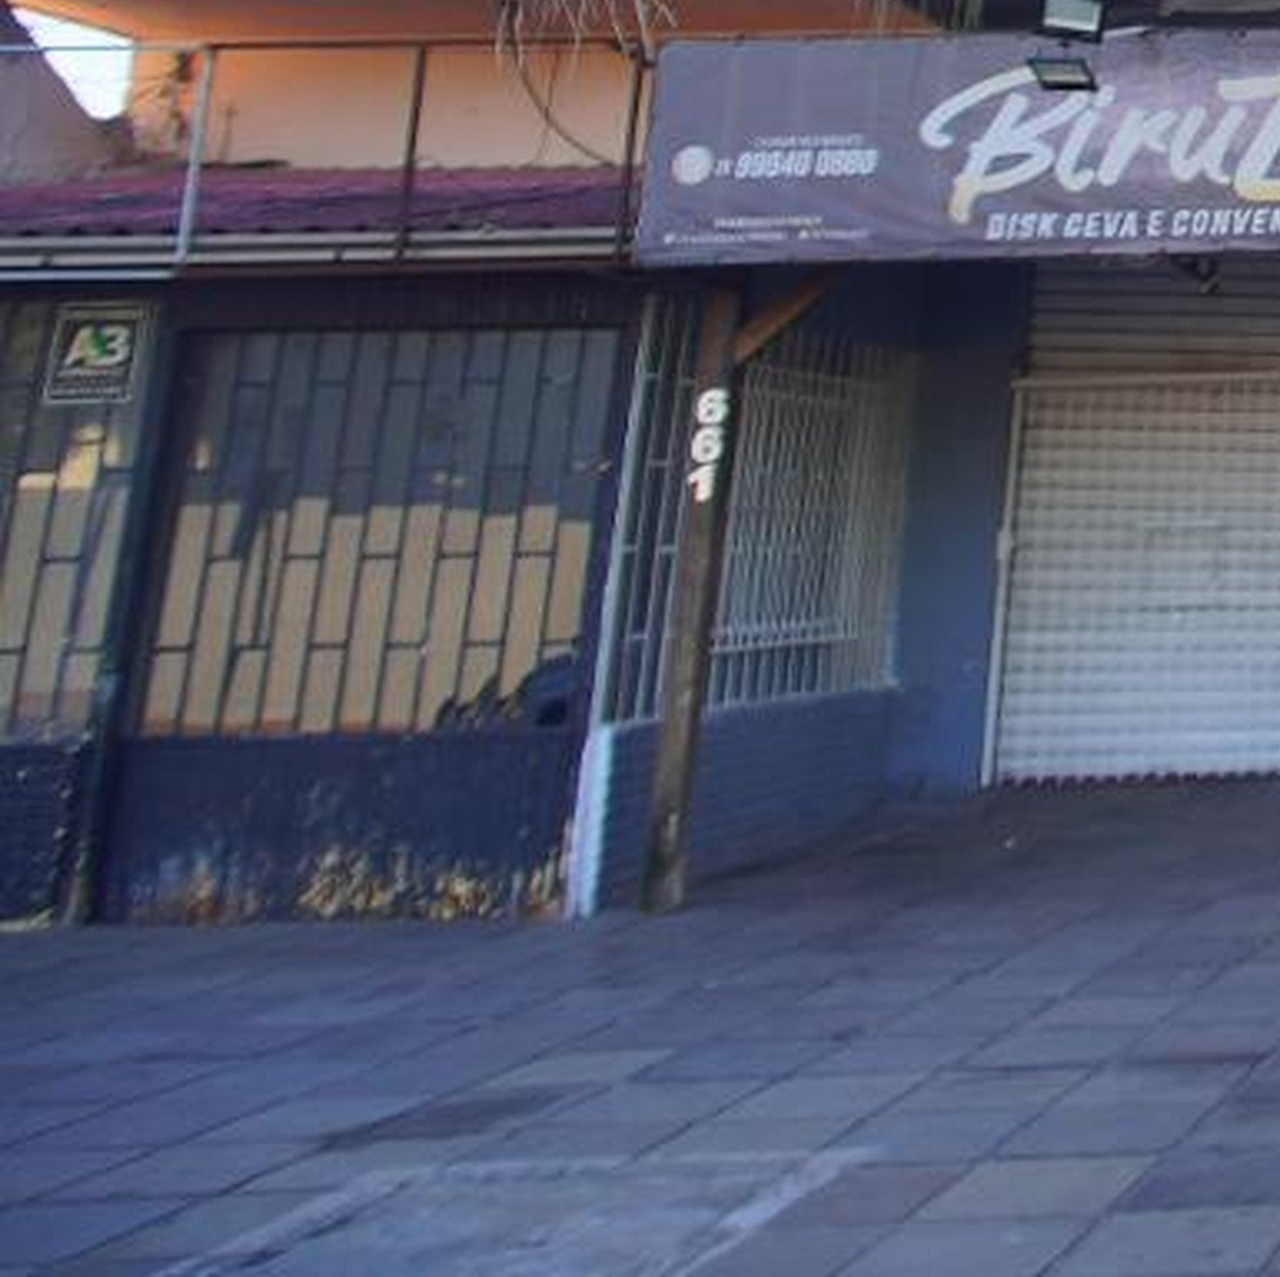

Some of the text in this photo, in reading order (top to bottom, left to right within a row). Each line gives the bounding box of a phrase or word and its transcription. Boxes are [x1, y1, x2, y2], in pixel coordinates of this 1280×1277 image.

[986, 212, 1058, 242] DISK
[1062, 211, 1139, 241] CEVA
[1146, 210, 1161, 237] E
